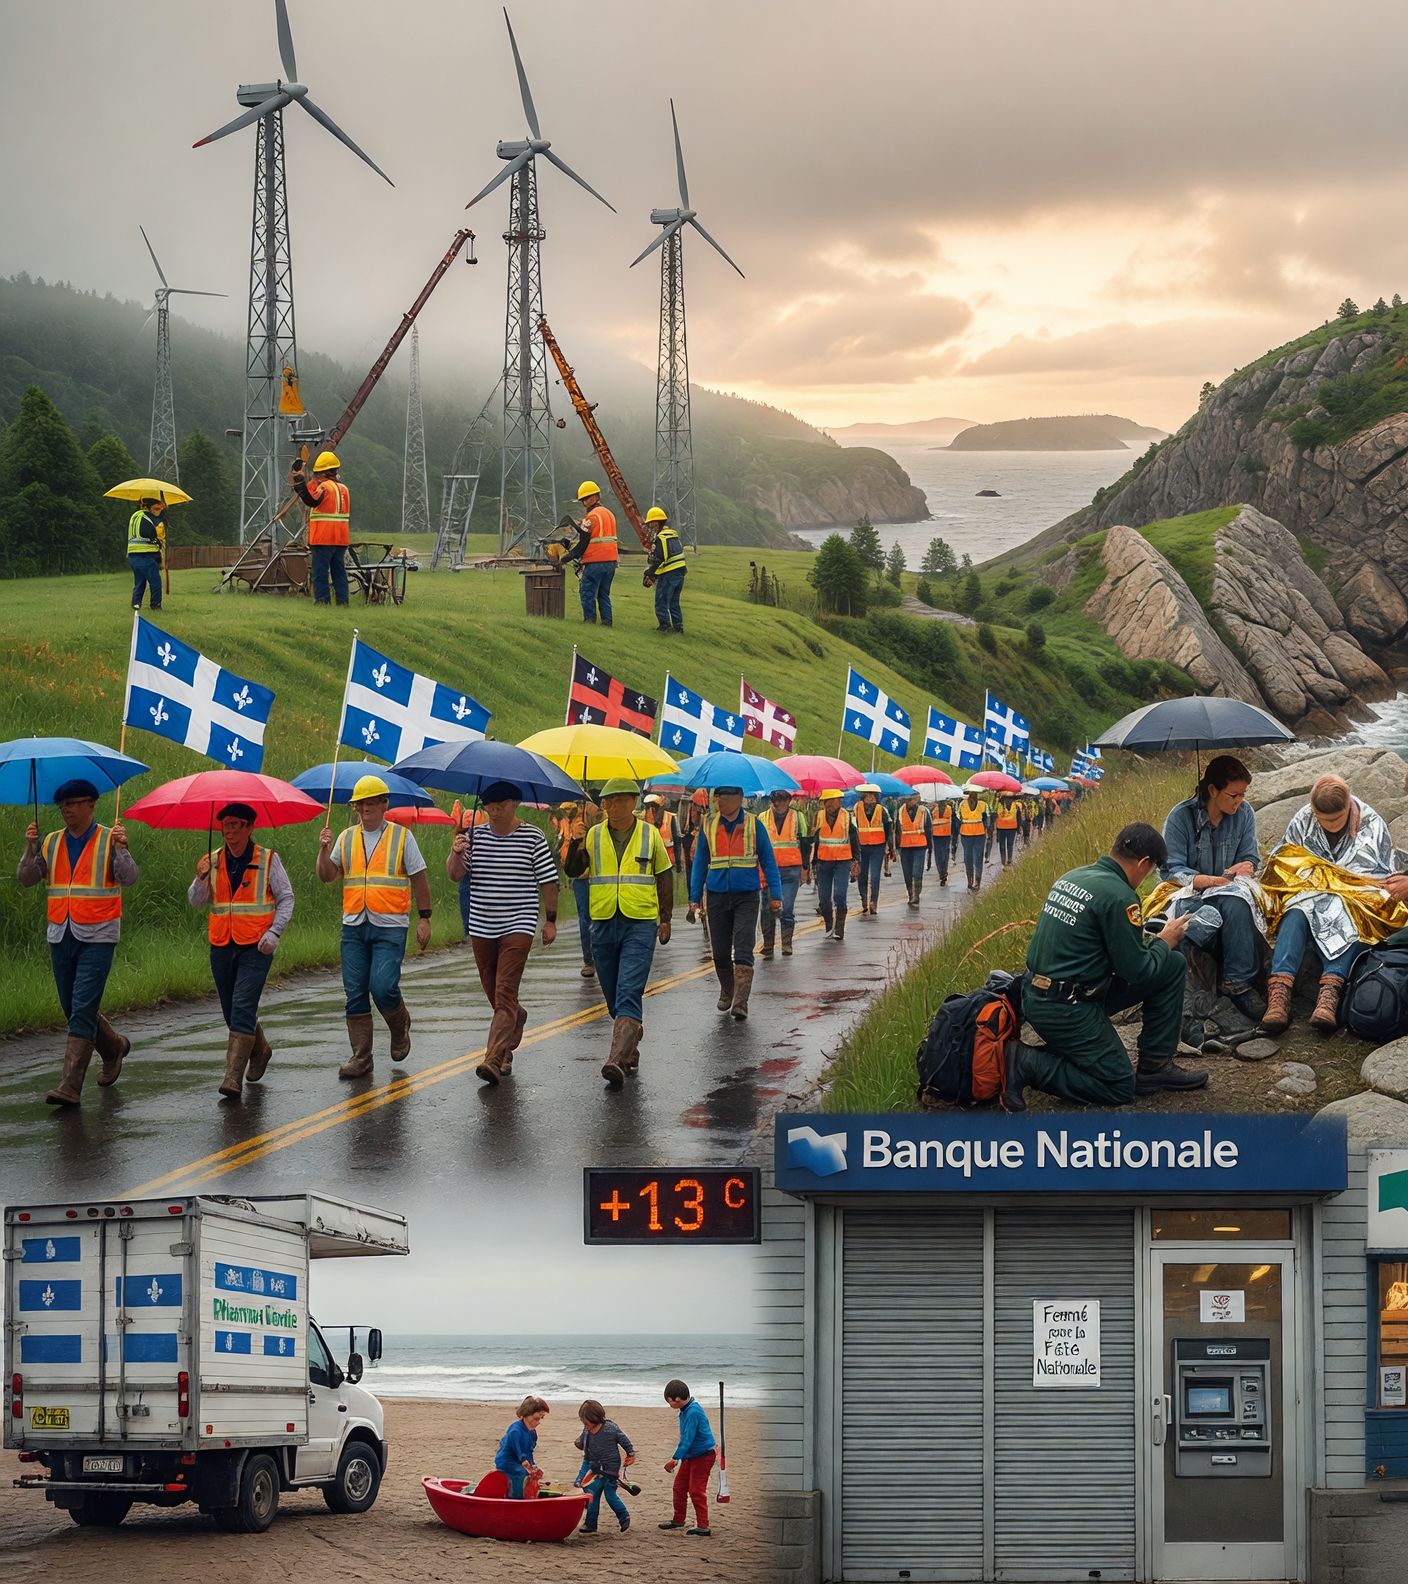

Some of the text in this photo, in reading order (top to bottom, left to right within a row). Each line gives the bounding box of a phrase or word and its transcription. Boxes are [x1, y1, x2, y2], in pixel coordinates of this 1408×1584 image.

[862, 1129, 1239, 1178] Banque Nationale
[600, 1179, 704, 1231] +13
